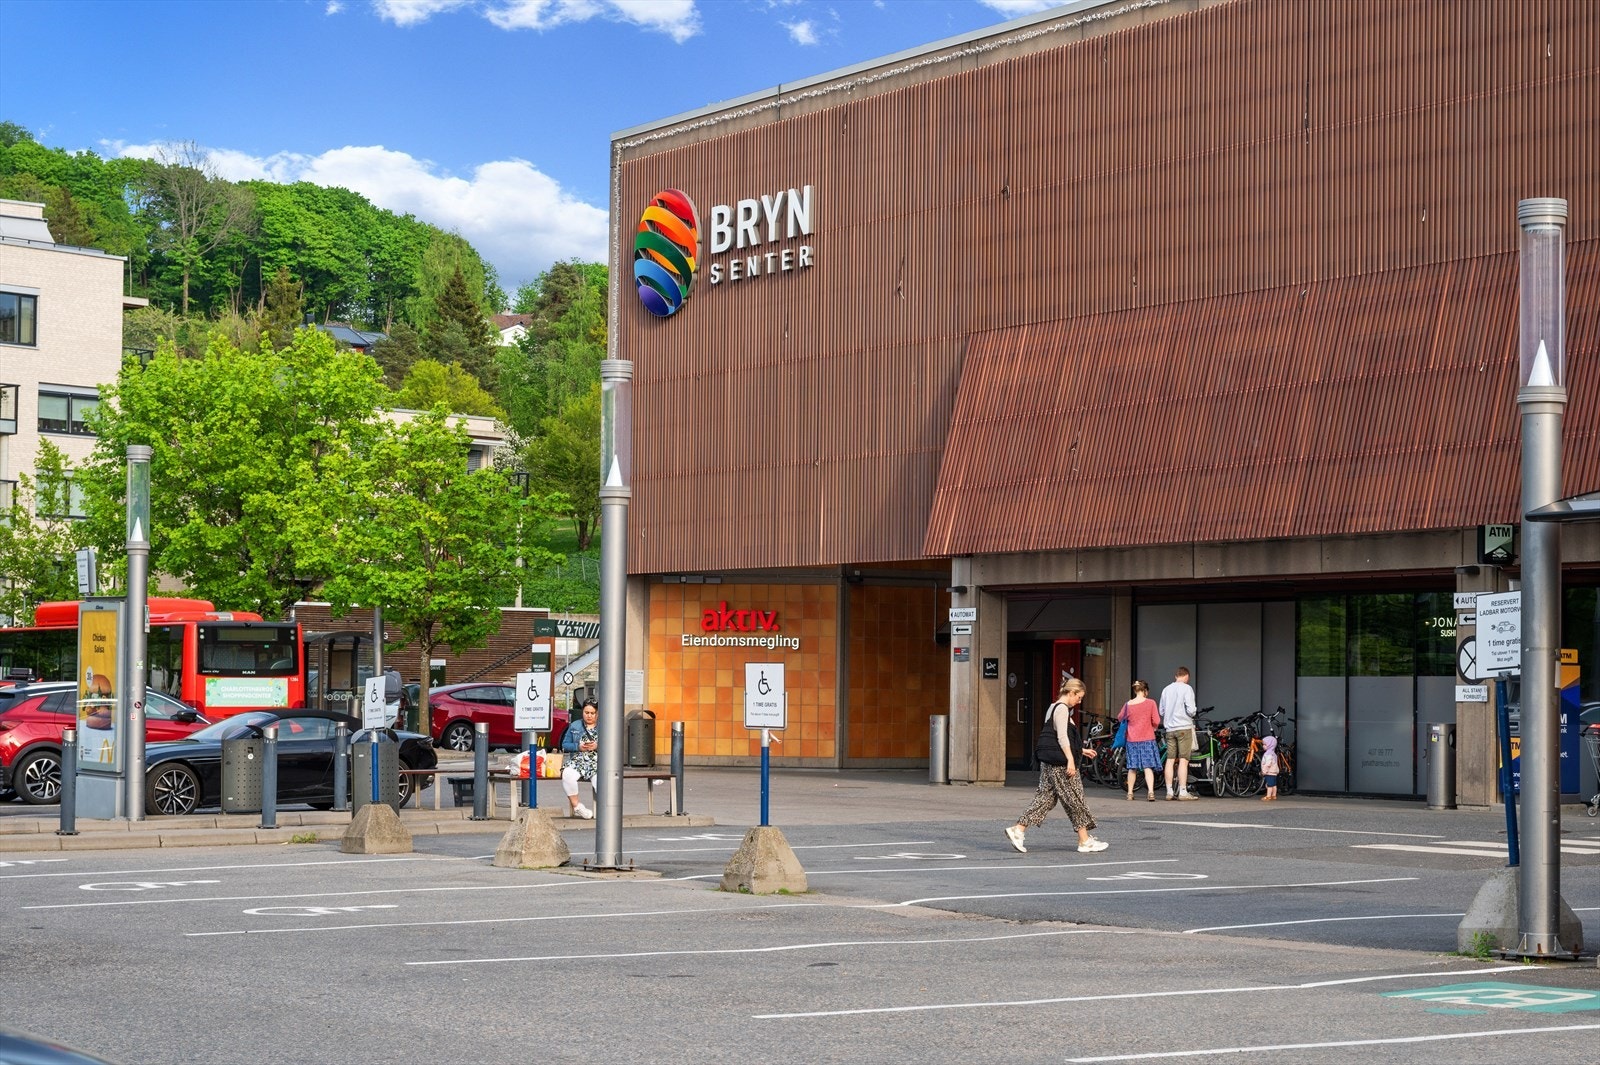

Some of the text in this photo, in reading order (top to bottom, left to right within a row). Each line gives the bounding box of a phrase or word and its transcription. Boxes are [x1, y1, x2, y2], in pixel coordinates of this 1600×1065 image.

[711, 185, 814, 254] BRYN
[710, 245, 814, 285] SENTER
[1489, 526, 1511, 538] ATM
[1460, 596, 1477, 605] AUTO
[1490, 598, 1520, 607] RESERVERT
[1479, 606, 1521, 617] LADBAR MOTORV
[92, 633, 107, 642] Chicken
[681, 634, 800, 650] Eiendomsmegling
[1492, 639, 1505, 647] time
[94, 645, 105, 654] Salsa
